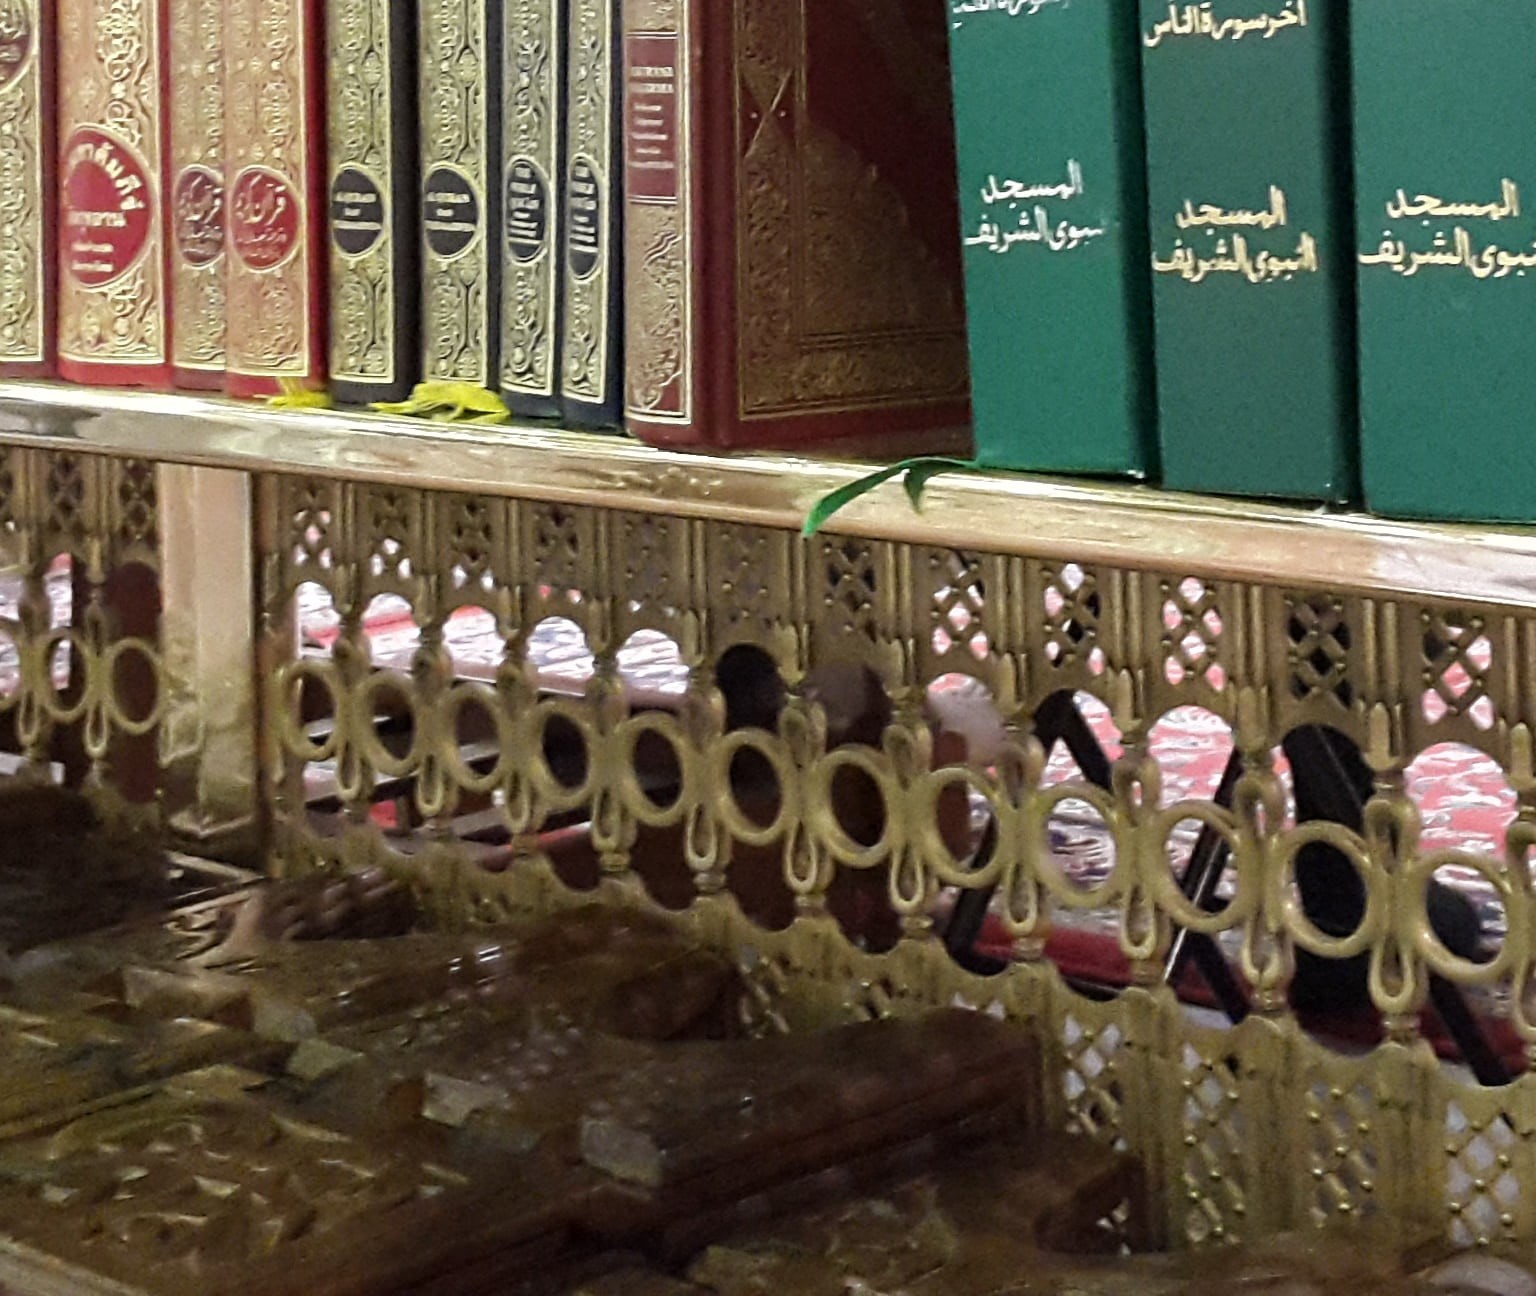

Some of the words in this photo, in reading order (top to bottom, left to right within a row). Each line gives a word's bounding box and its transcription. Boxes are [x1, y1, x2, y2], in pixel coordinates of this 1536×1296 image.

[980, 159, 1083, 210] المسجد
[1386, 178, 1519, 226] المسجد
[963, 203, 1051, 254] الشريف
[1176, 184, 1287, 237] المسجد
[1151, 231, 1249, 283] الشريف
[1357, 226, 1472, 276] الشريف
